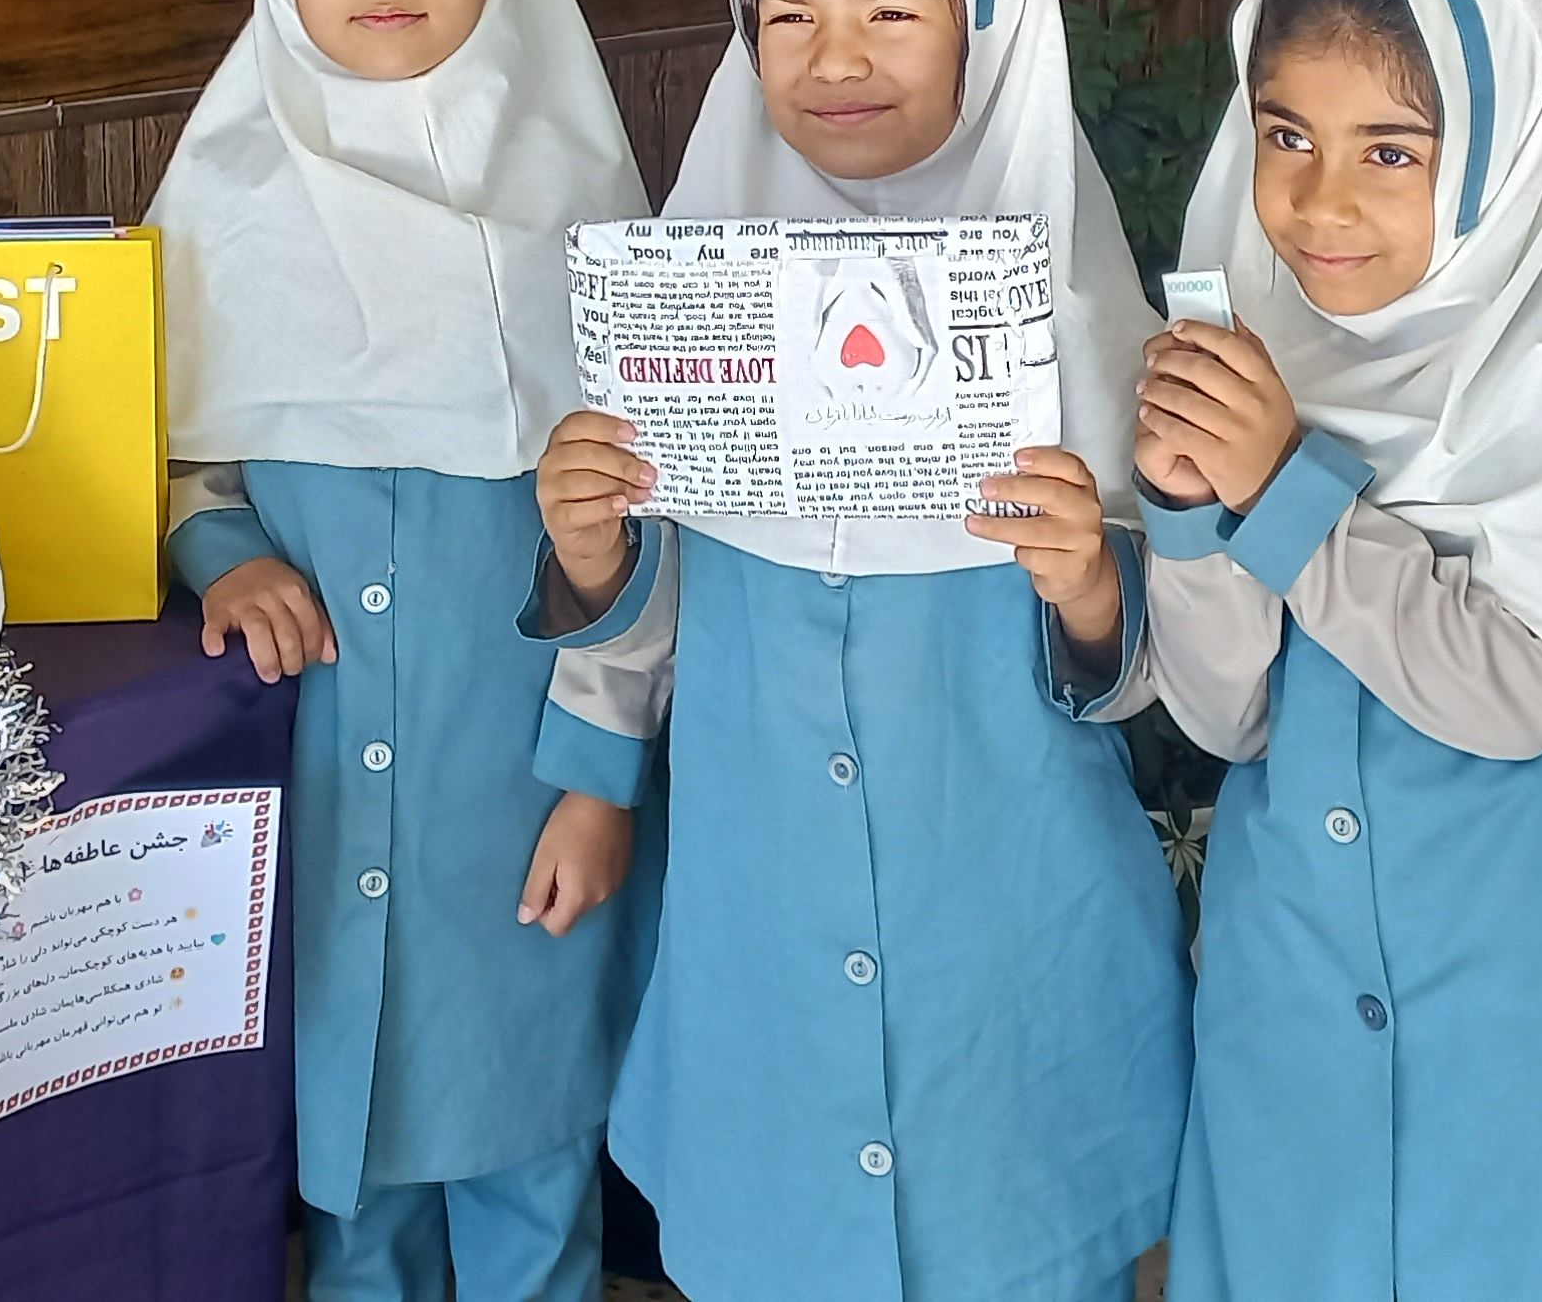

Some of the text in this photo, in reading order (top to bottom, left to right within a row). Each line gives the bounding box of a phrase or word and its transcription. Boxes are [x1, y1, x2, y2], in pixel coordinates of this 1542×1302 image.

[625, 223, 652, 238] my
[666, 224, 724, 240] breath
[737, 221, 779, 237] your
[959, 229, 1020, 242] You are
[697, 245, 725, 261] my
[750, 247, 779, 260] are
[948, 270, 996, 284] words
[950, 289, 978, 303] this
[583, 307, 608, 323] you
[951, 334, 994, 383] IS
[619, 356, 776, 384] LOVE DEFINED
[794, 472, 815, 480] rest
[817, 471, 833, 479] the
[836, 470, 850, 479] for
[853, 469, 873, 478] you
[875, 469, 897, 477] love
[914, 468, 932, 476] No,
[935, 467, 957, 476] life?
[130, 831, 188, 860] جشن
[31, 894, 122, 933] با هم مهربان باشیم
[165, 915, 178, 926] هر
[132, 917, 159, 930] دست
[90, 922, 127, 944] کوچکی
[31, 946, 47, 963] دلی
[166, 943, 173, 954] با
[135, 973, 164, 991] شادی
[21, 1006, 47, 1027] شادی
[134, 1008, 149, 1022] هم
[54, 1021, 88, 1043] قهرمان
[15, 1037, 50, 1060] مهربانی
